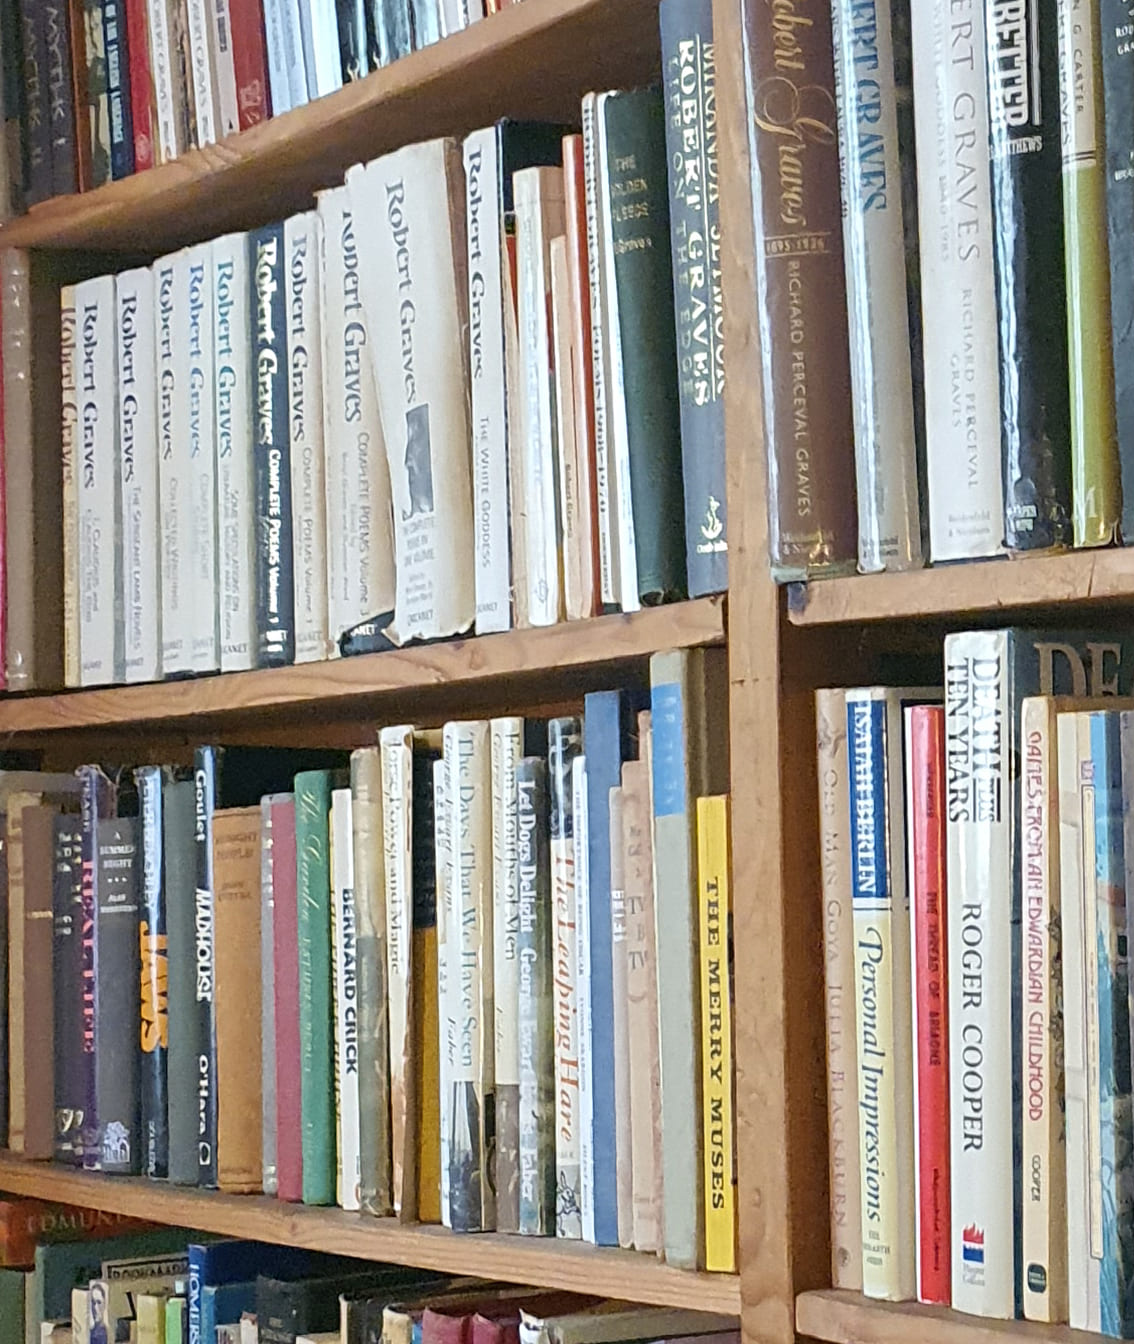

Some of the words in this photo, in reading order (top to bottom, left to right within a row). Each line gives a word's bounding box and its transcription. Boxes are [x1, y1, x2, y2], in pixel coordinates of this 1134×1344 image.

[678, 38, 701, 210] ROBERT
[755, 76, 834, 228] Graves
[855, 71, 888, 212] GRAVES
[952, 91, 980, 264] GRAVES
[121, 289, 138, 389] Robert
[159, 266, 174, 360] Robert
[216, 260, 234, 354] Robert
[384, 181, 413, 290] Robert
[401, 297, 418, 404] Graves
[688, 229, 710, 407] GRAVES
[787, 259, 804, 344] RICHARD
[962, 288, 978, 380] RICHARD
[122, 394, 138, 484] Graves
[162, 368, 176, 462] Graves
[217, 363, 237, 460] Graves
[791, 345, 810, 440] PERCEVAL
[964, 389, 980, 489] PERCEVAL
[797, 443, 813, 518] GRAVES
[195, 769, 207, 842] Goulet
[195, 887, 212, 1004] MADHOUSE
[342, 887, 356, 1002] BERNARD
[706, 877, 721, 946] THE
[961, 903, 984, 1012] ROGER
[343, 1006, 358, 1075] CRICK
[708, 960, 723, 1086] MERRY
[857, 926, 886, 1056] Personal
[198, 1053, 209, 1134] O'Hara
[962, 1022, 985, 1154] COOPER
[709, 1100, 725, 1211] MUSES
[860, 1060, 886, 1222] Impressions
